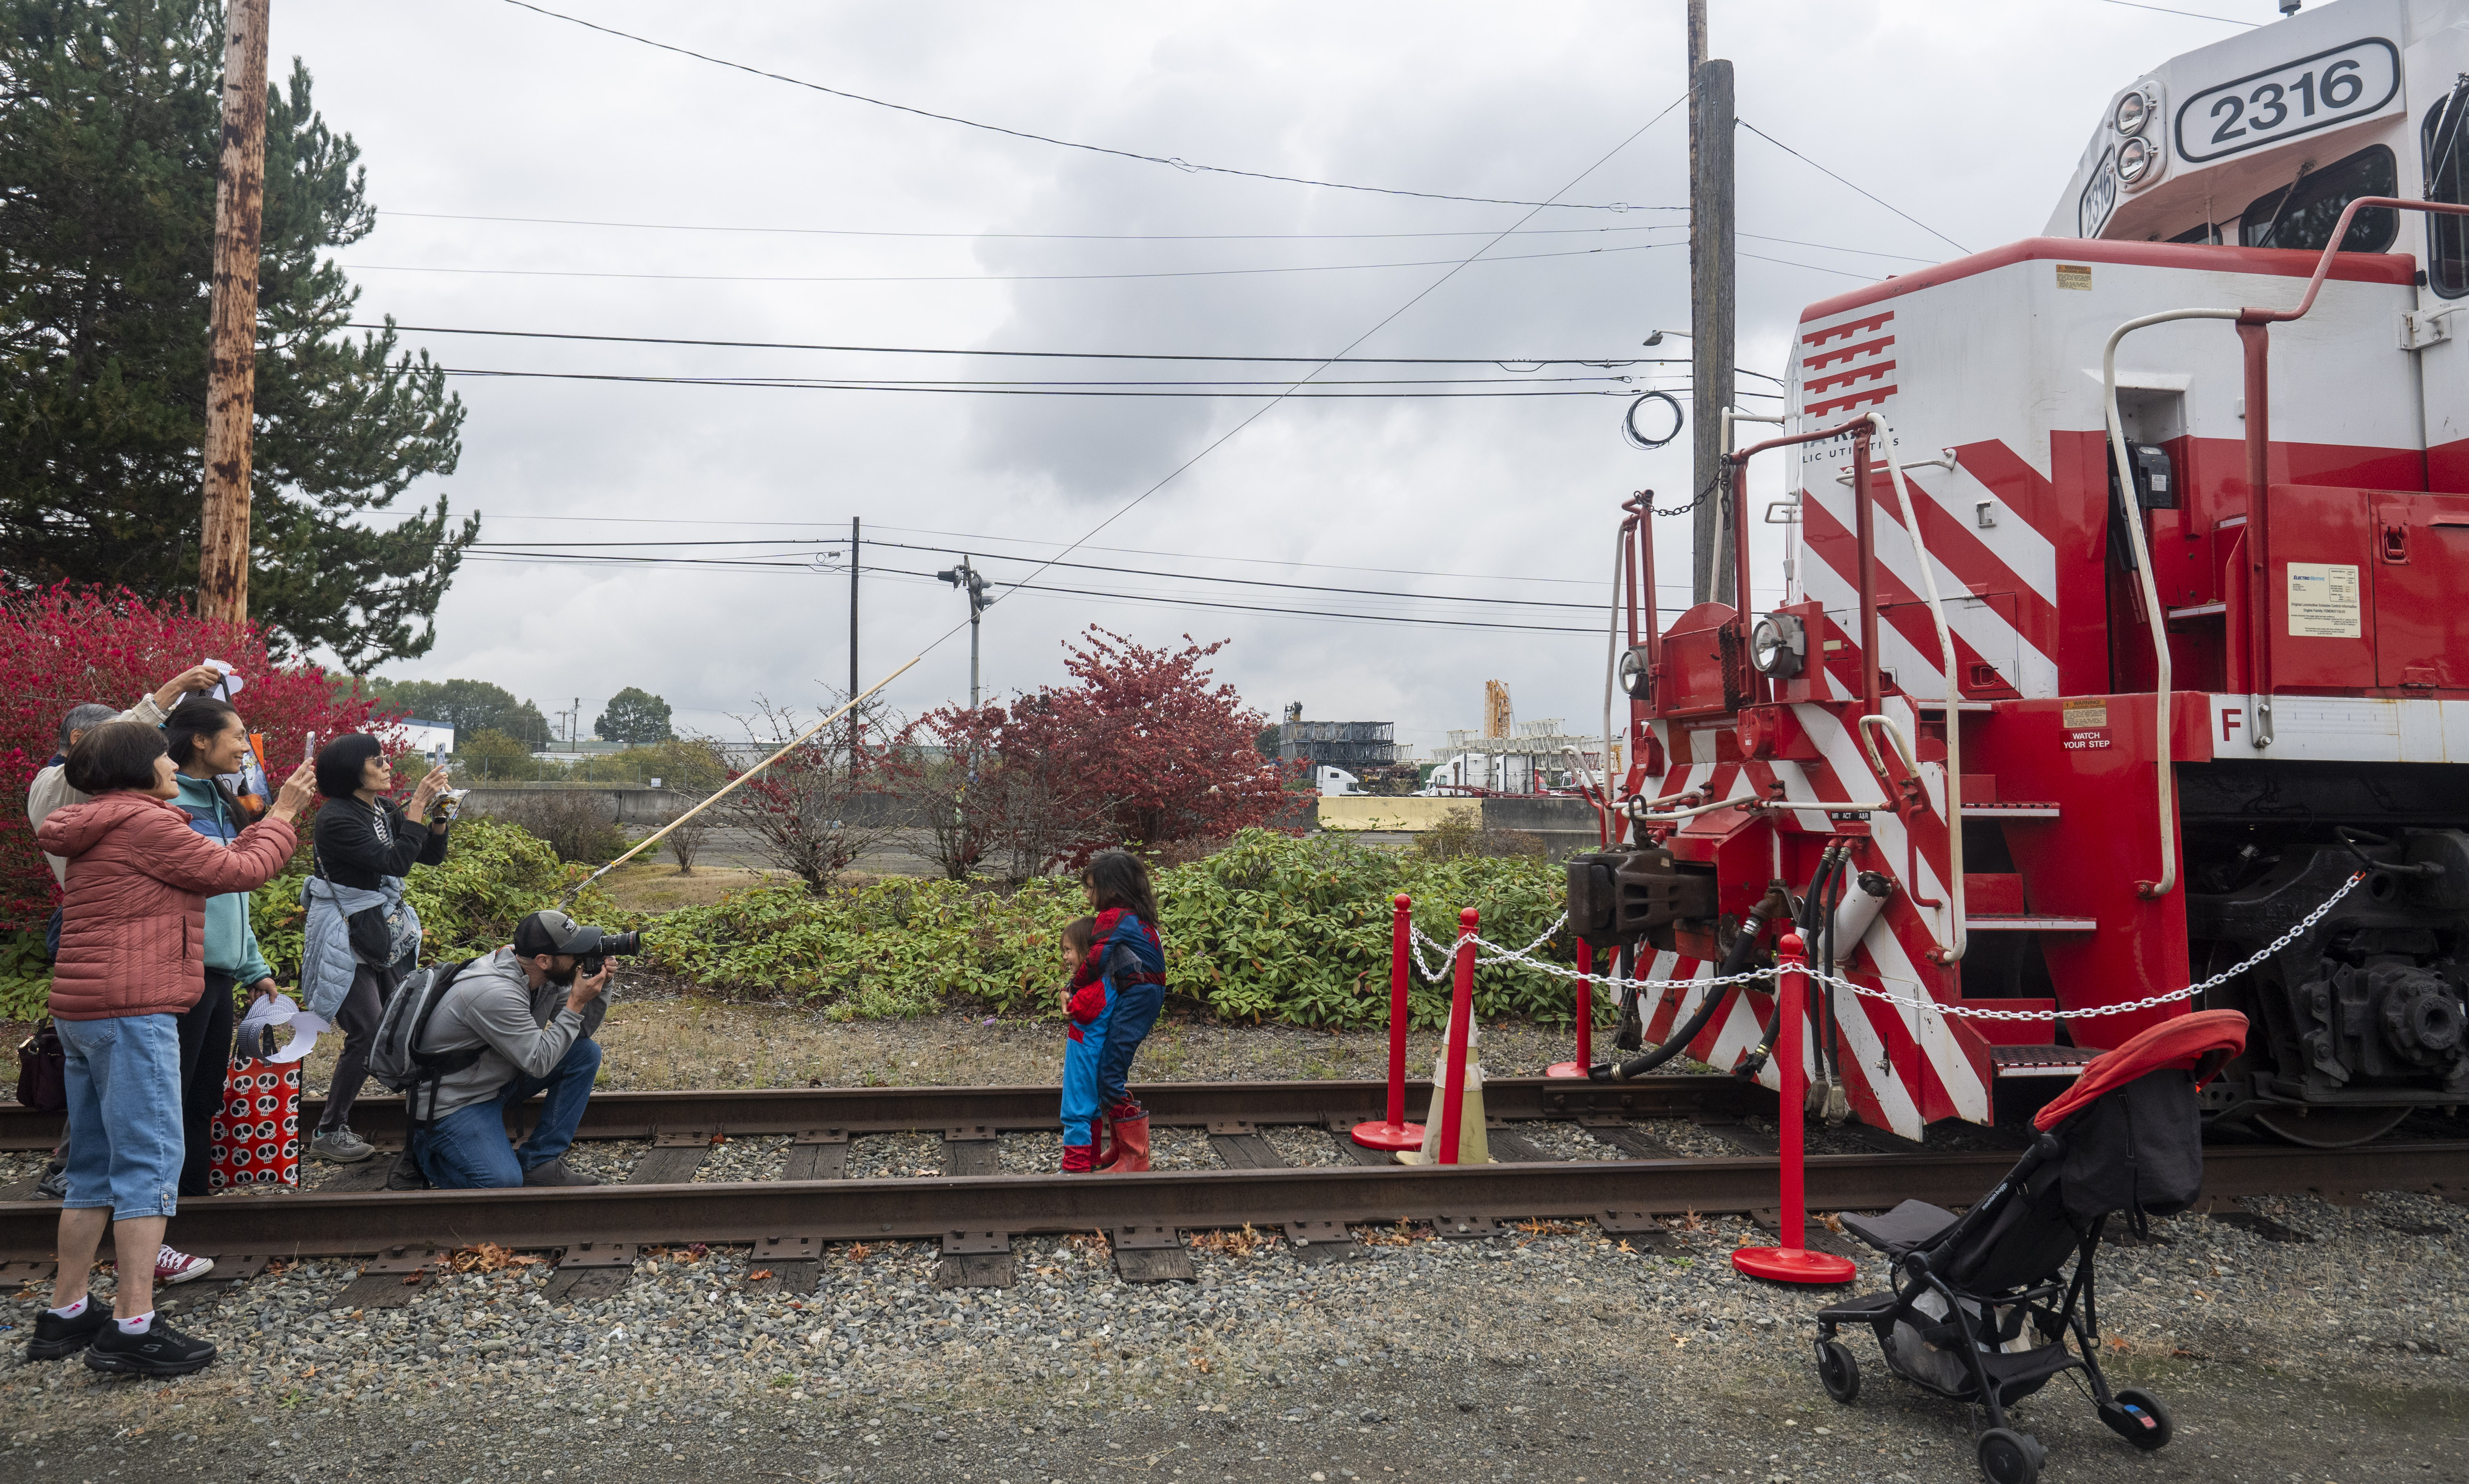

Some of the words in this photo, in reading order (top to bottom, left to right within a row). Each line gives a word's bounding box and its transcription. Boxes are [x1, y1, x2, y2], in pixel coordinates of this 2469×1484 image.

[2211, 60, 2363, 145] 2316
[2086, 162, 2111, 237] 2316
[1830, 438, 1899, 458] UTITIS
[2222, 709, 2241, 741] F
[1982, 1193, 1997, 1210] mountain
[1995, 1182, 2007, 1195] buggy
